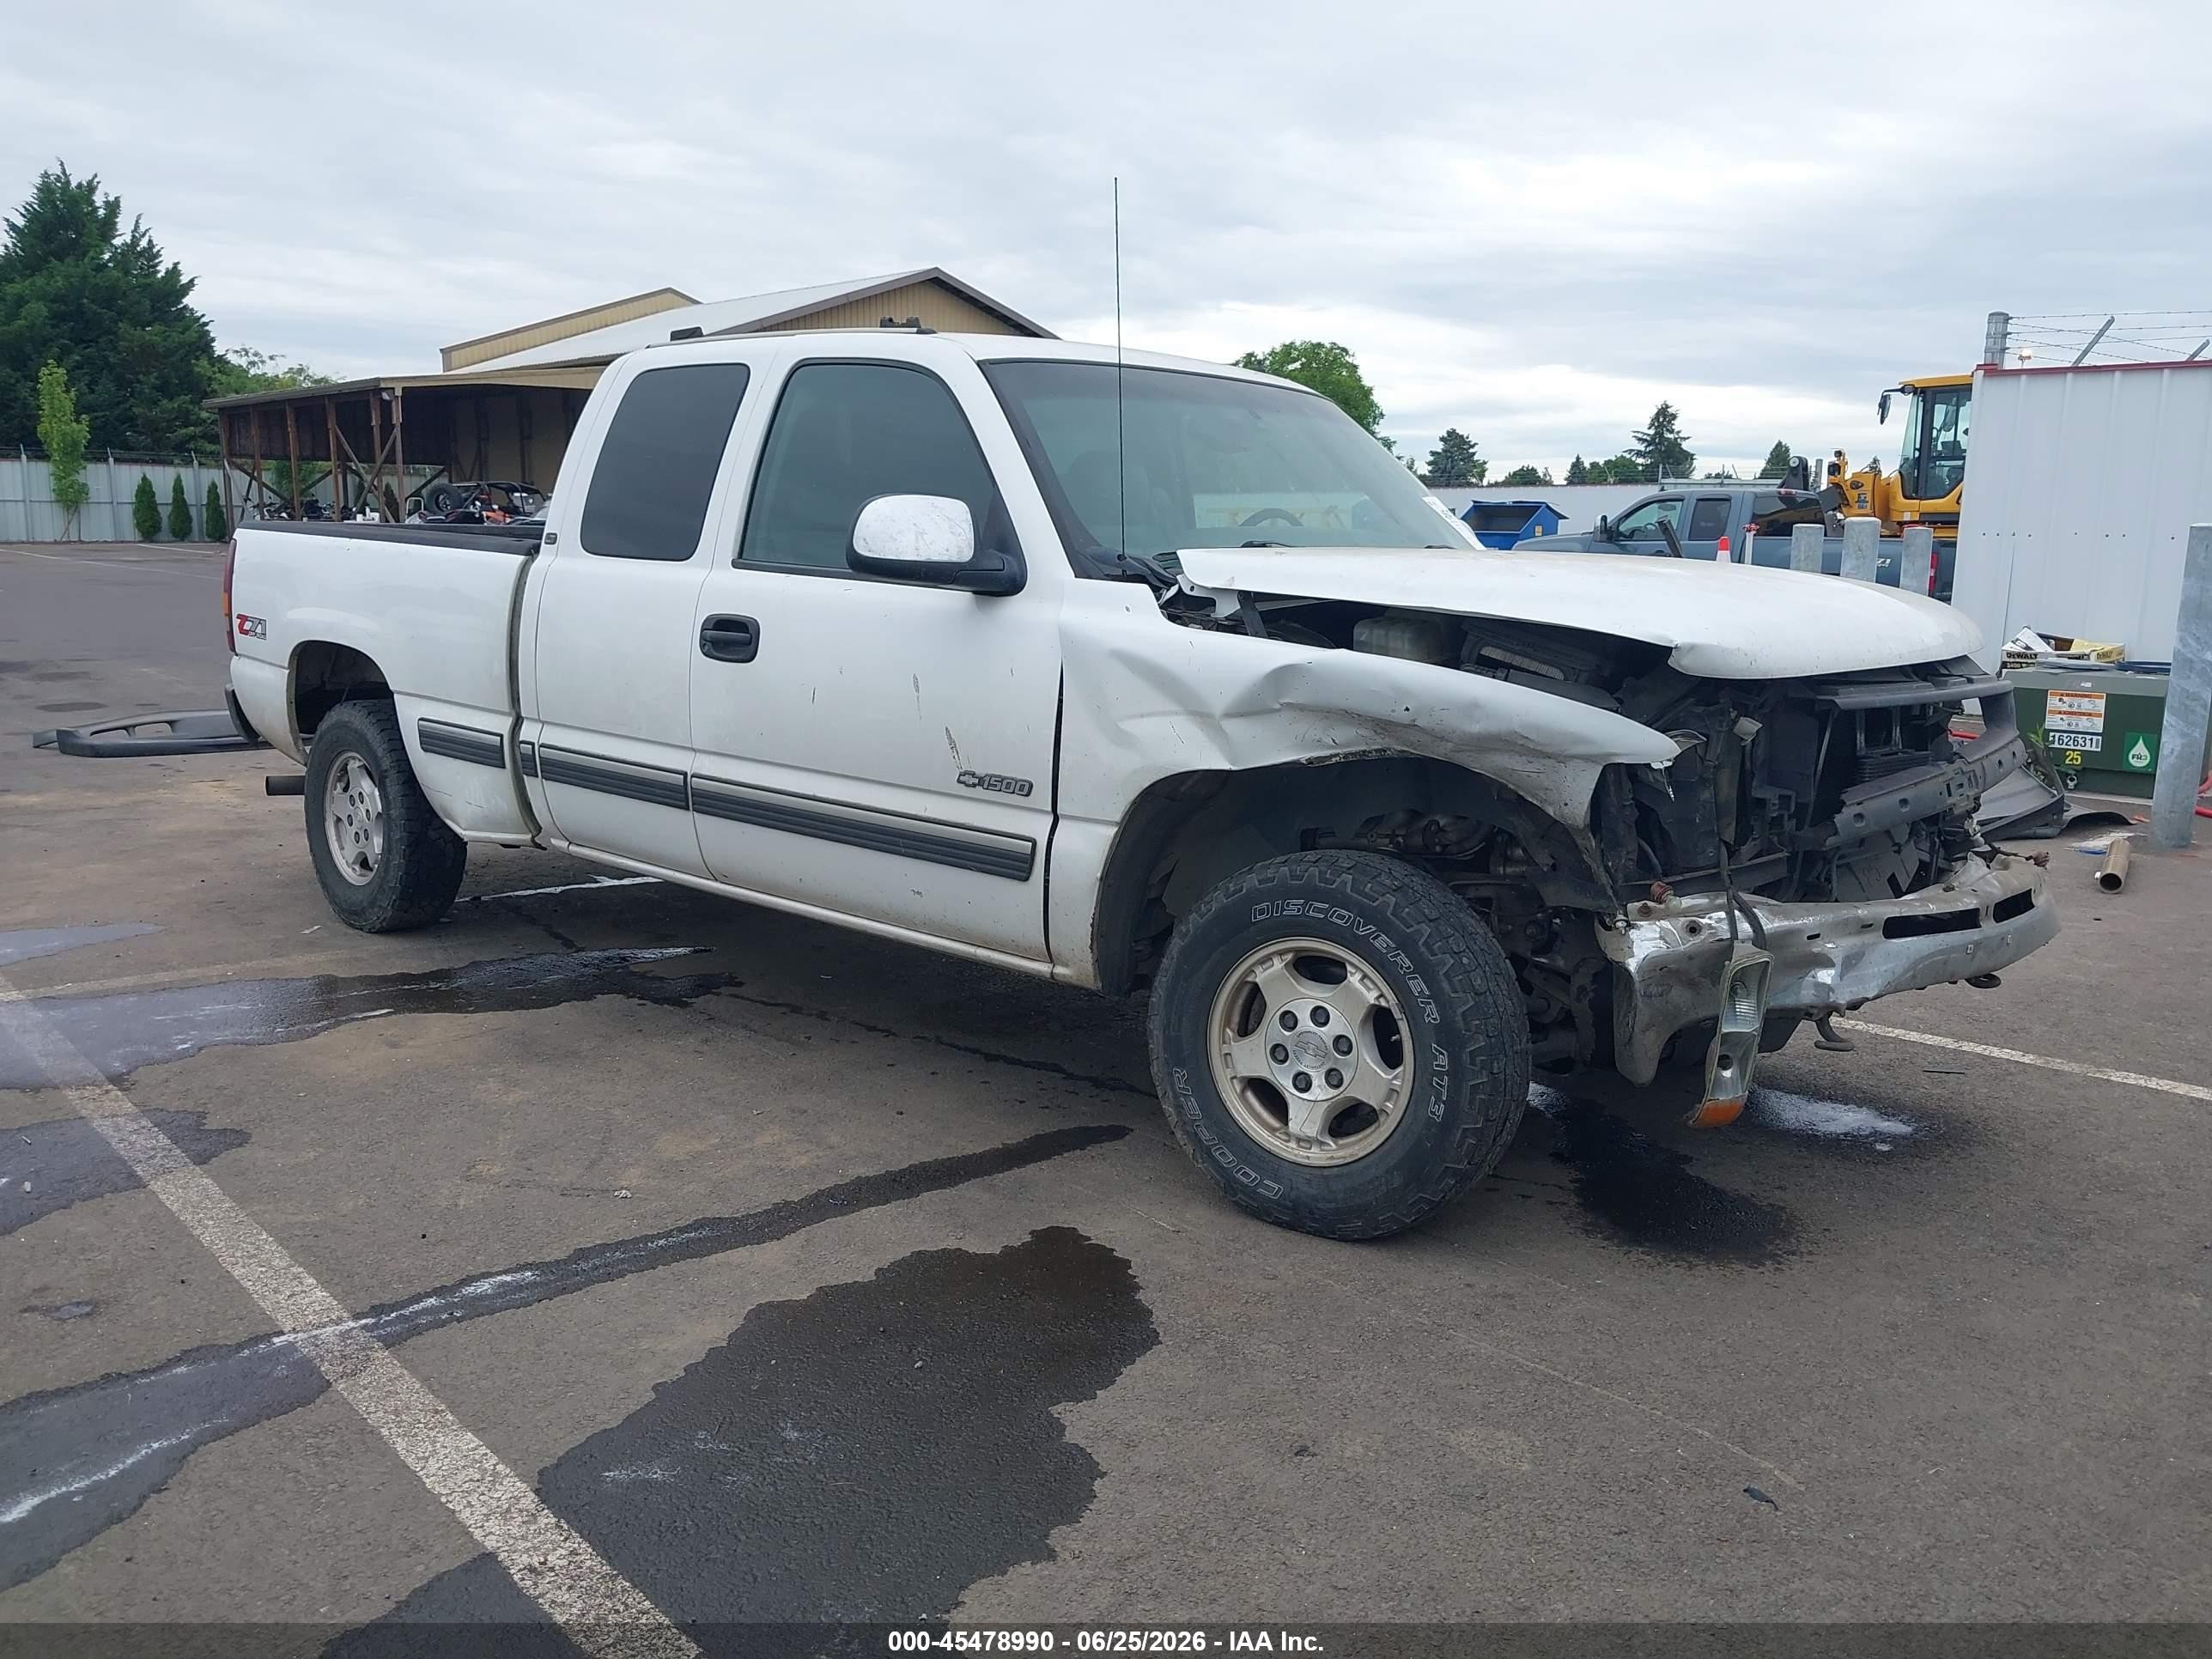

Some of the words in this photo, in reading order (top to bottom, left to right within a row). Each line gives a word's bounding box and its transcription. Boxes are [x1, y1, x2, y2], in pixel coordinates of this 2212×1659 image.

[2050, 733, 2094, 749] 162631
[2064, 750, 2082, 765] 25
[981, 775, 1032, 796] 1500
[1251, 899, 1441, 1024] DISCOVERER
[1428, 1042, 1449, 1122] AT3
[1172, 1067, 1285, 1200] COOPER
